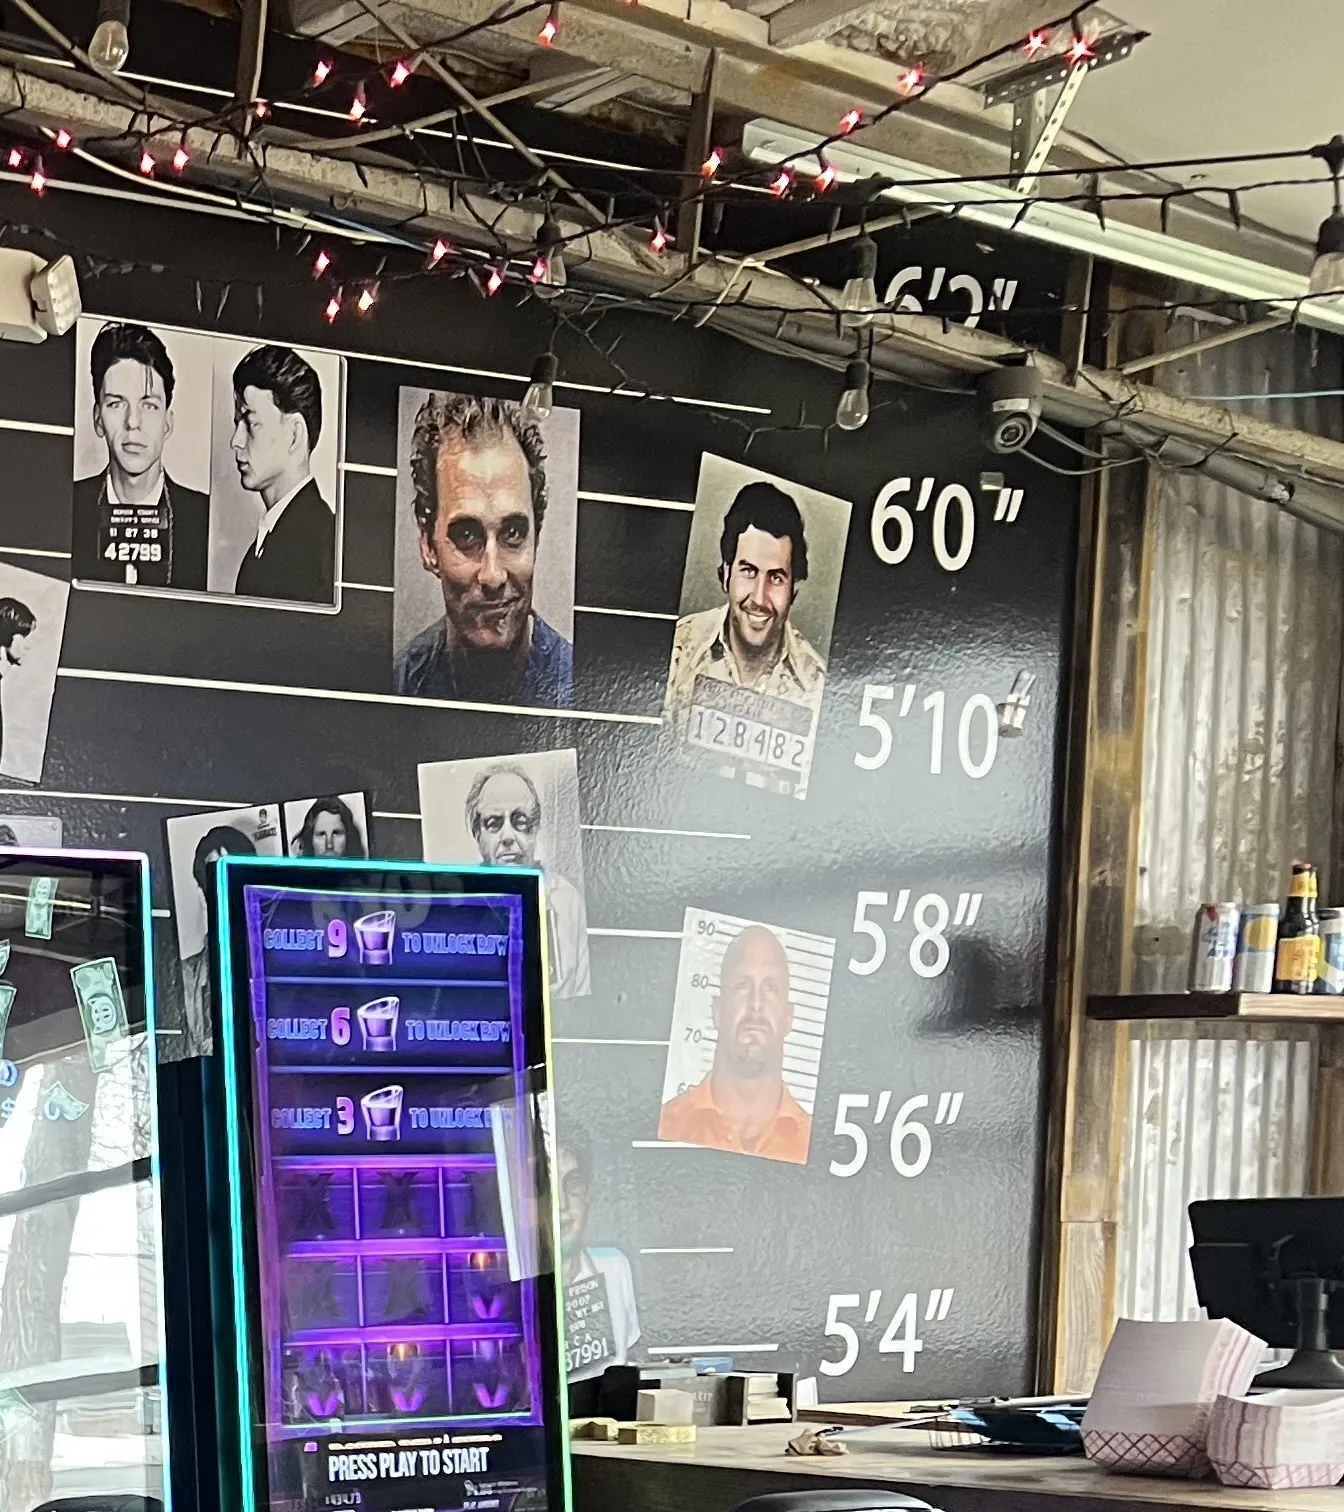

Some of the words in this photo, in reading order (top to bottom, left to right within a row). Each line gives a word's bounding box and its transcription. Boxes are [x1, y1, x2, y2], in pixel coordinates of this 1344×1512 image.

[104, 542, 161, 562] 42799
[695, 711, 805, 767] 128482
[263, 928, 325, 951] COLLECT
[327, 918, 347, 958] 9
[401, 932, 422, 953] TO
[422, 932, 476, 954] UNLOCK
[477, 933, 508, 956] ROW
[697, 920, 715, 936] 90
[848, 890, 983, 978] 5'8"
[690, 973, 709, 990] 80
[267, 1018, 328, 1040] COLLECT
[331, 1006, 351, 1046] 6
[405, 1020, 425, 1041] TO
[426, 1020, 480, 1042] UNLOCK
[480, 1020, 511, 1043] ROW
[684, 1027, 702, 1044] 70
[271, 1108, 332, 1129] COLLECT
[336, 1096, 355, 1136] 3
[409, 1108, 429, 1129] TO
[829, 1091, 964, 1177] 5'6"
[819, 1288, 954, 1376] 5'4"
[328, 1454, 378, 1482] PRESS
[379, 1452, 418, 1479] PLAY
[421, 1451, 441, 1476] TO
[443, 1447, 490, 1474] START
